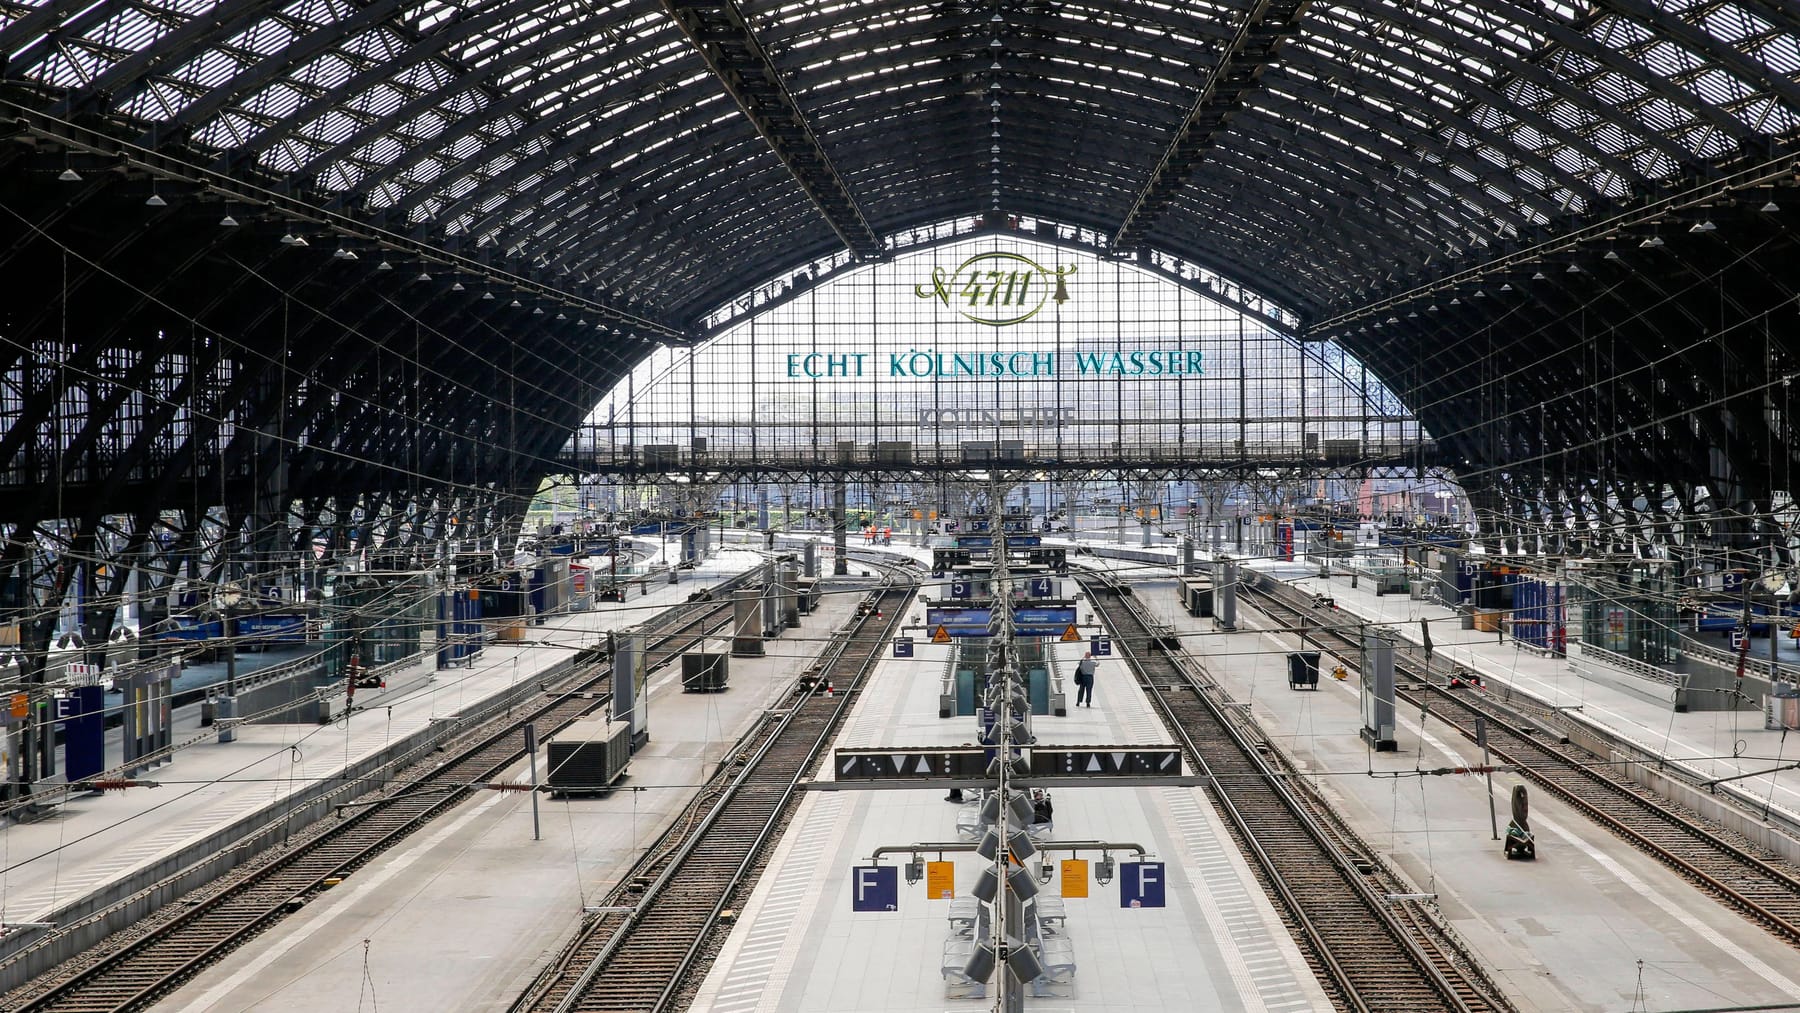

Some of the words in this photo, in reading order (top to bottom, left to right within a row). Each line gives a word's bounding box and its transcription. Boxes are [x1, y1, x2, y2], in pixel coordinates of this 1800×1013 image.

[960, 269, 1033, 306] 4711
[786, 353, 868, 378] ECHT
[889, 348, 1054, 377] KÖLNISCH
[1075, 351, 1204, 375] WASSER
[919, 407, 1001, 430] KÖLN
[1019, 407, 1076, 429] HBF
[1465, 565, 1474, 576] D
[502, 580, 511, 591] D
[954, 580, 964, 594] 5
[1038, 578, 1049, 593] 4
[1725, 573, 1735, 588] 3
[268, 587, 279, 599] 6
[895, 638, 906, 654] E
[1098, 636, 1109, 651] E
[57, 698, 71, 718] E
[858, 868, 879, 901] F
[1138, 864, 1158, 897] F
